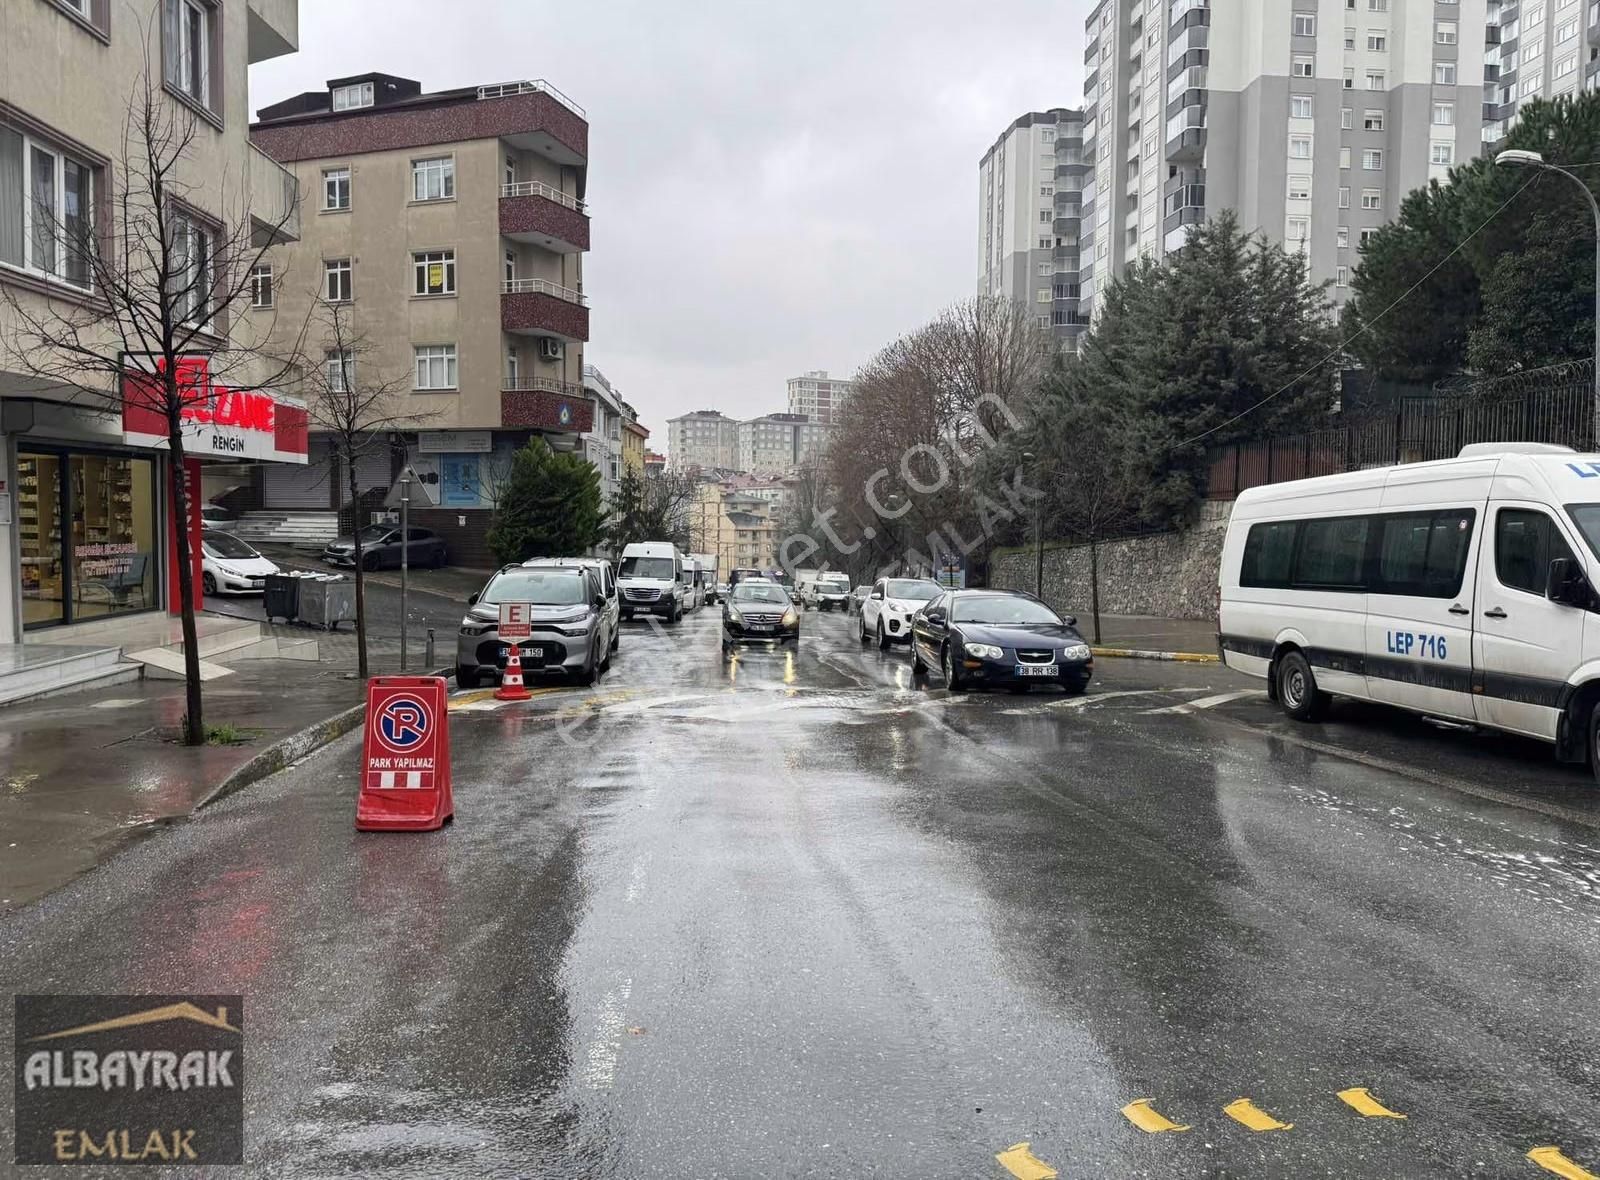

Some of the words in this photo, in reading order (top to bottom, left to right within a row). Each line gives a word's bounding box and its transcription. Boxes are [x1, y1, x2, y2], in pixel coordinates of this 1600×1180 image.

[212, 434, 245, 452] RENGİN
[509, 605, 521, 622] E
[1387, 631, 1414, 655] LEP
[1418, 634, 1447, 660] 716
[370, 758, 391, 768] PARK
[394, 758, 433, 768] YAPILMAZ
